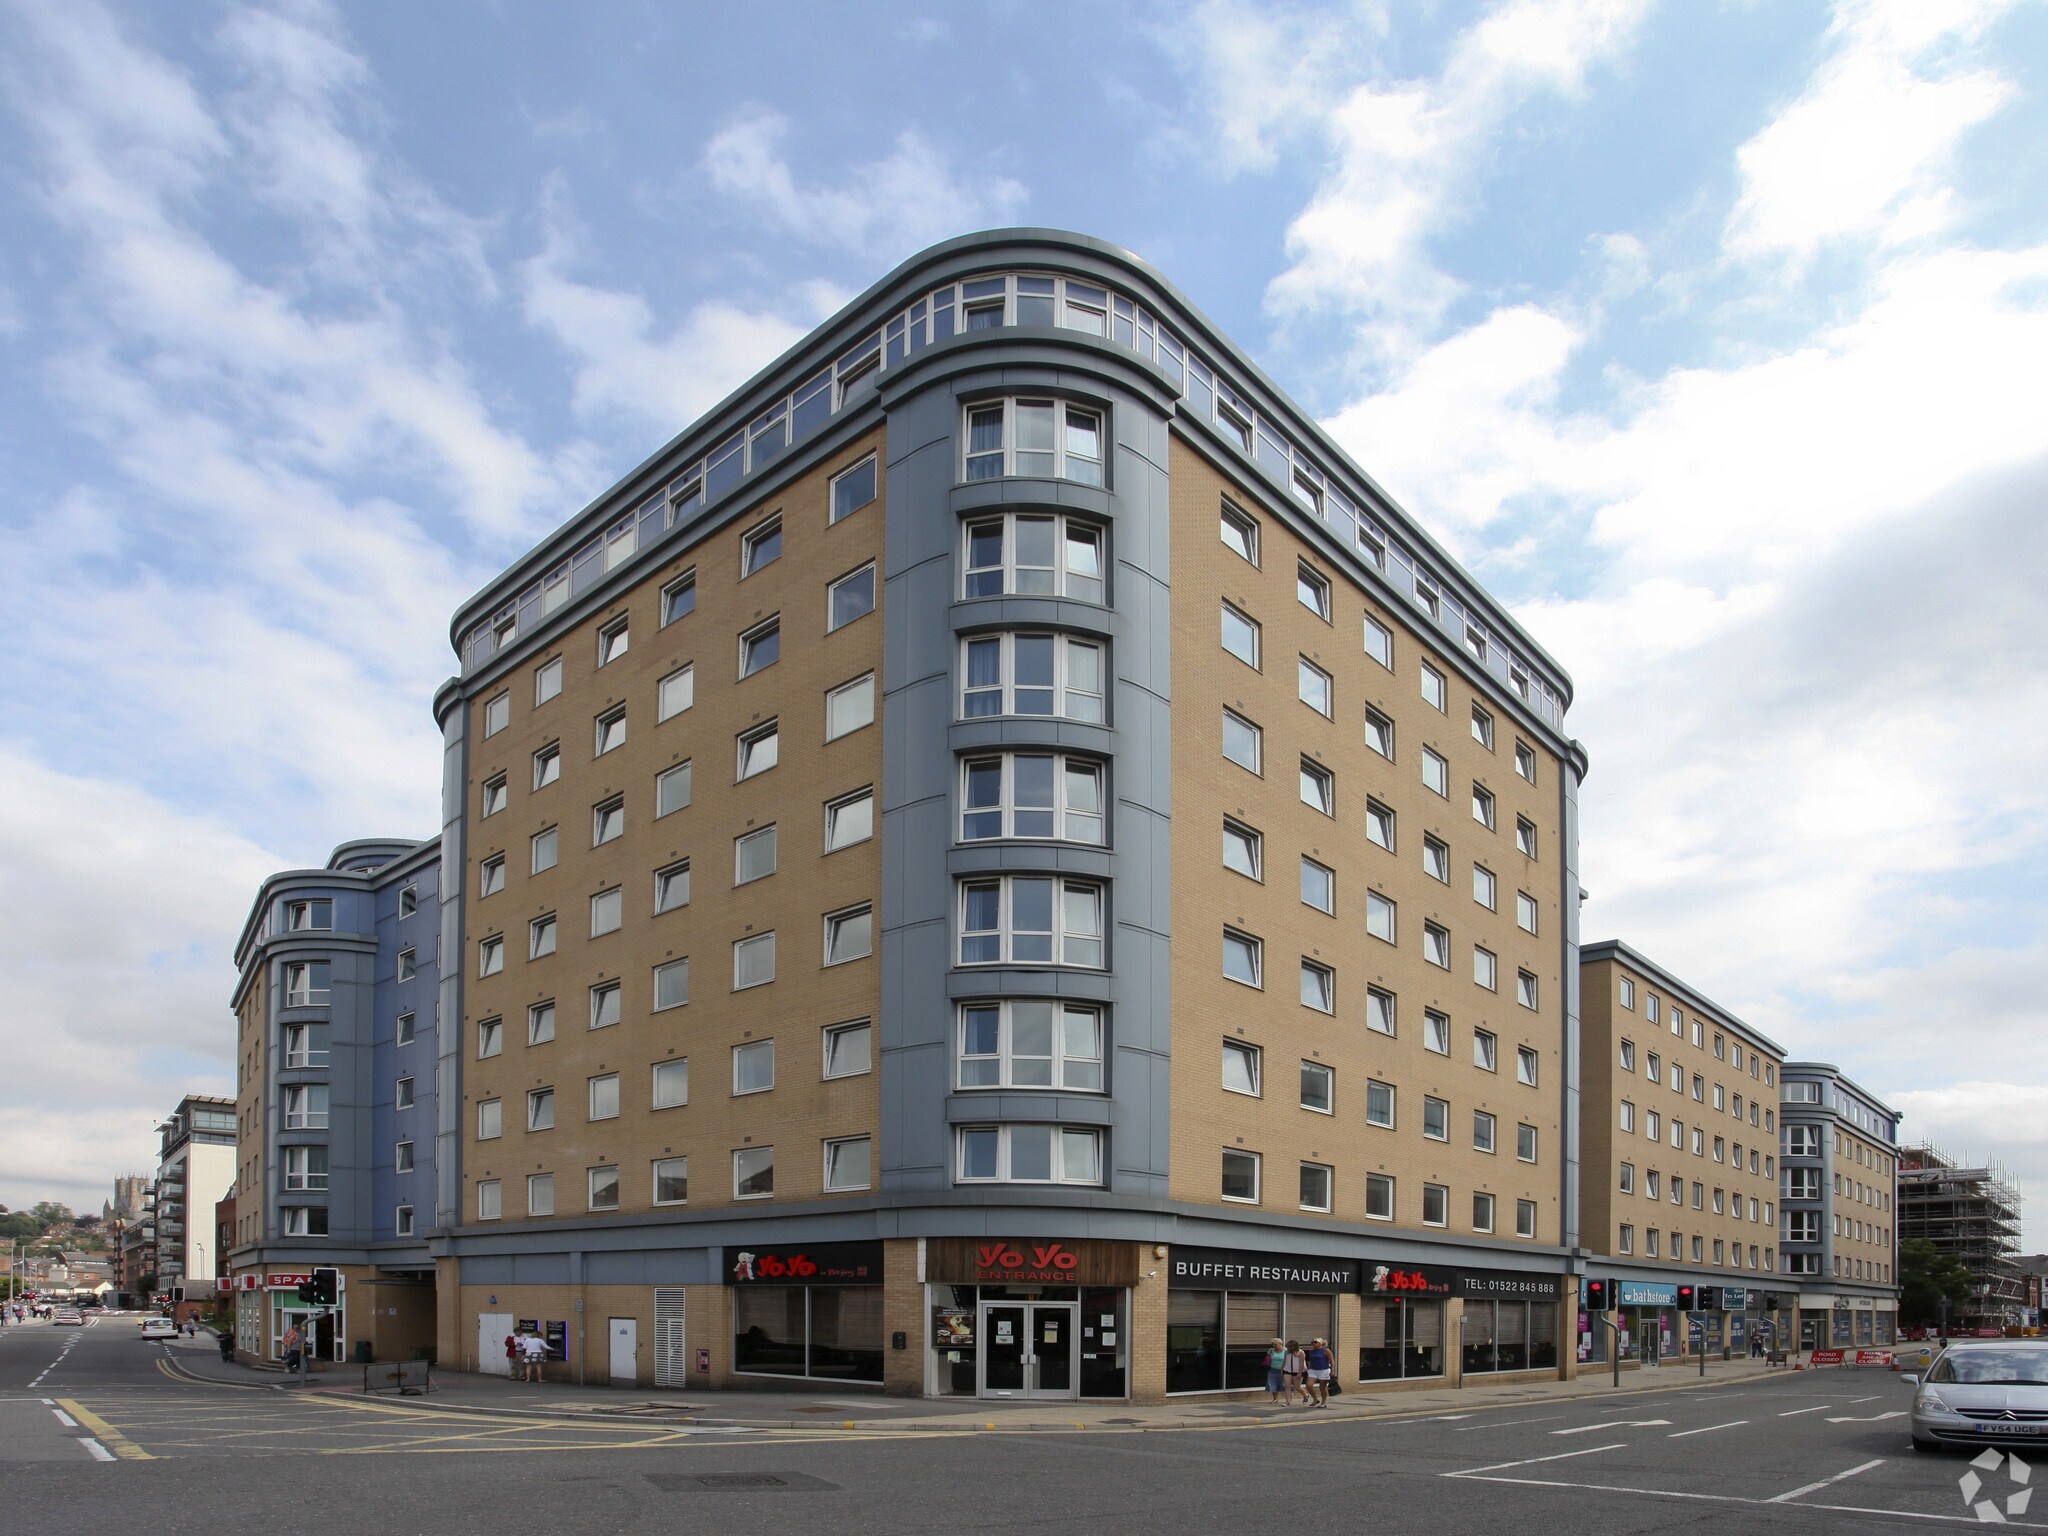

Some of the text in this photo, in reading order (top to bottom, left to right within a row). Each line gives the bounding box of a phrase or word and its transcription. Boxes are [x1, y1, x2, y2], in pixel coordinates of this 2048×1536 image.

[978, 1270, 1076, 1281] ENTRANCE
[1176, 1261, 1350, 1283] BUFFET RESTAURANT
[1464, 1278, 1554, 1293] TEL: 01522 845 888
[1632, 1288, 1671, 1304] bathstore
